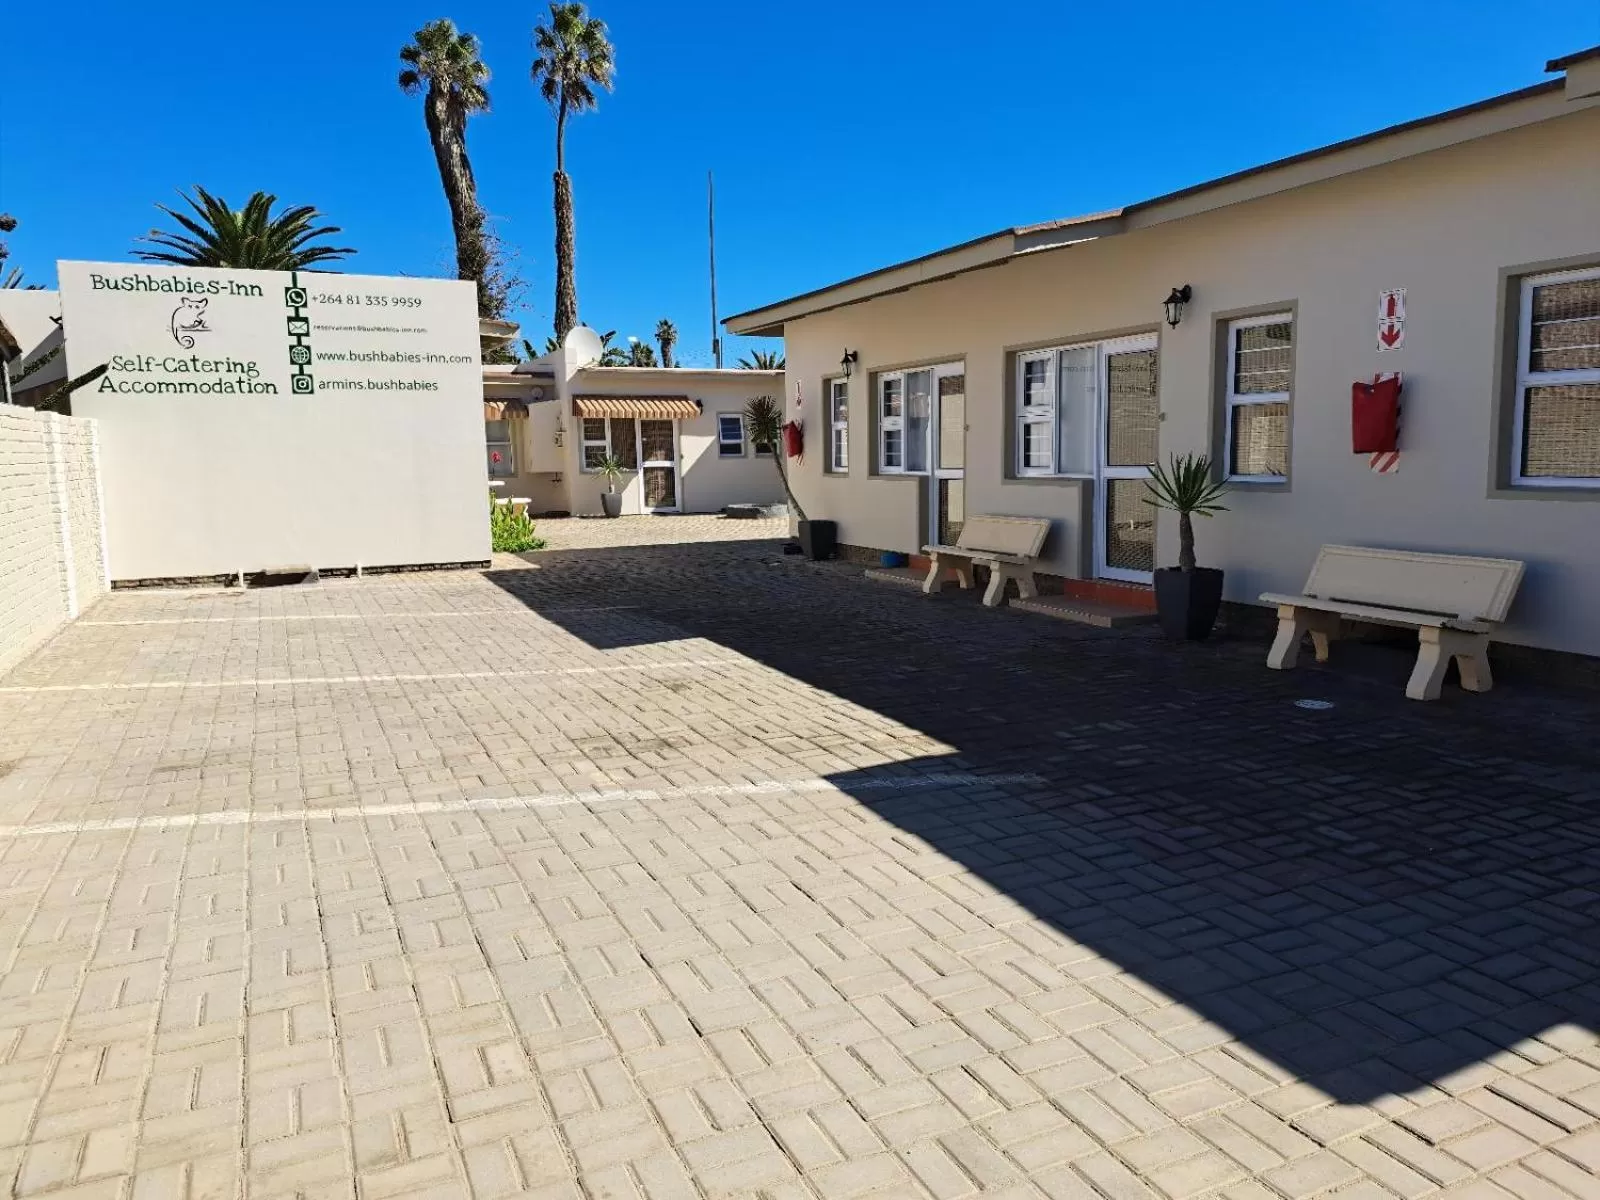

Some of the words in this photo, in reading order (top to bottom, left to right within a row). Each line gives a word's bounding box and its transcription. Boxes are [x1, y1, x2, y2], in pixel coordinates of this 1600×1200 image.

[311, 294, 343, 305] +264
[346, 294, 361, 305] 81
[365, 295, 388, 307] 335
[391, 297, 422, 308] 9959
[313, 324, 428, 334] reservans@busabsinn.om
[316, 350, 473, 364] www.bushbabies-inn.com
[111, 354, 260, 378] Self-Catering
[97, 375, 278, 395] Accommodation
[318, 378, 439, 392] armins.bushbabies
